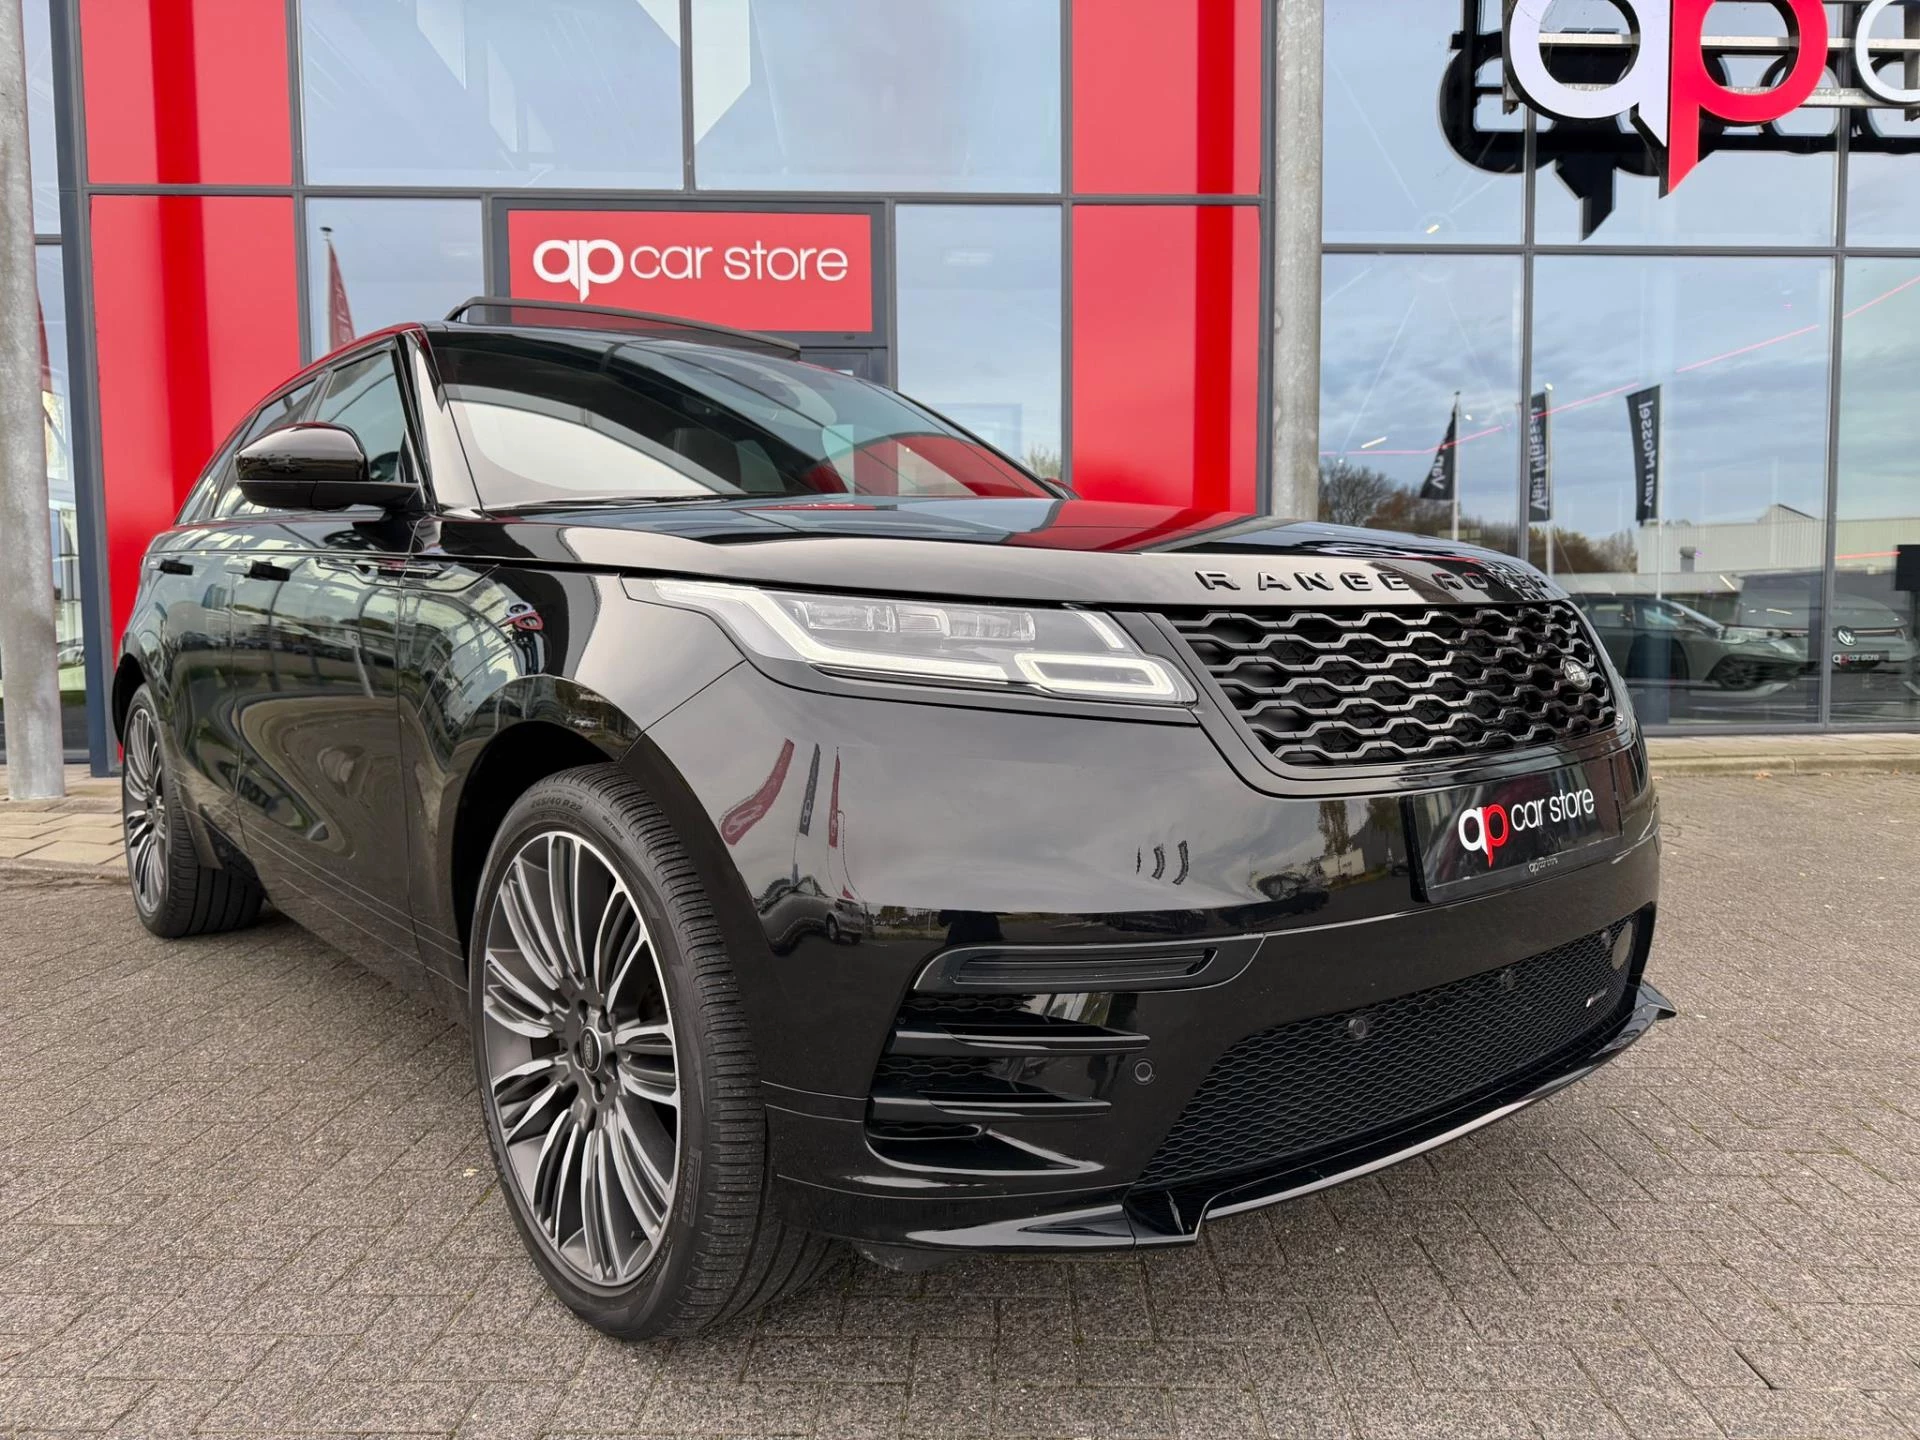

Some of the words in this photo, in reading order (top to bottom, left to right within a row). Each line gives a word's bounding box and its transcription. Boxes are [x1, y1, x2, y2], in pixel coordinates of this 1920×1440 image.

[1509, 0, 1828, 194] ap
[532, 239, 624, 303] ap
[629, 245, 713, 280] car
[723, 240, 848, 282] store
[1195, 571, 1410, 591] RANGE
[1458, 803, 1509, 867] ap
[1511, 798, 1545, 831] car
[1549, 788, 1595, 822] store
